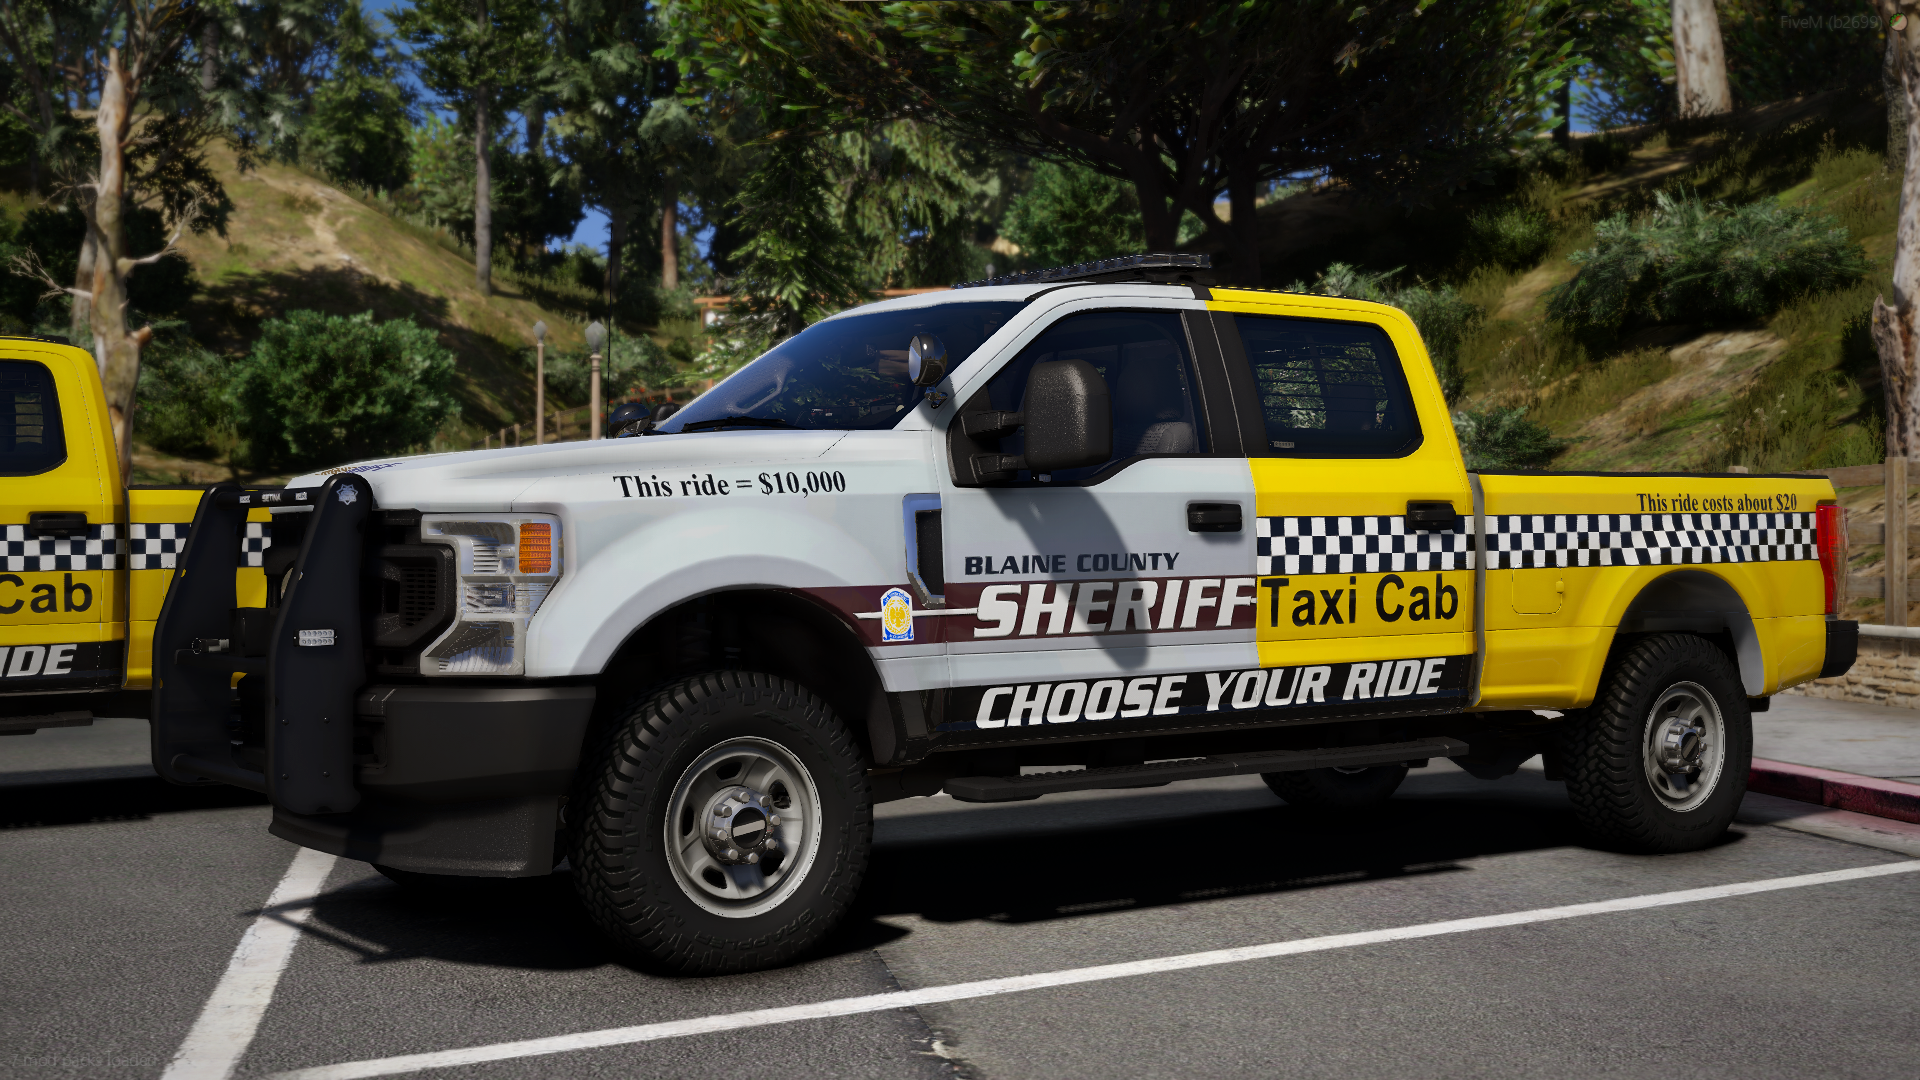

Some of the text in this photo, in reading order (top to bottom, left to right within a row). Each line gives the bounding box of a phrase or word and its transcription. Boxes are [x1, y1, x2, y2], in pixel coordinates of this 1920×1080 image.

[612, 471, 846, 498] This ride = $10,000
[1636, 493, 1798, 513] This ride costs about $20
[965, 552, 1180, 575] BLAINE COUNTY
[0, 573, 93, 615] Cab
[973, 578, 1257, 638] SHERIFF
[1260, 573, 1459, 628] Taxi Cab
[976, 658, 1447, 729] CHOOSE YOUR RIDE
